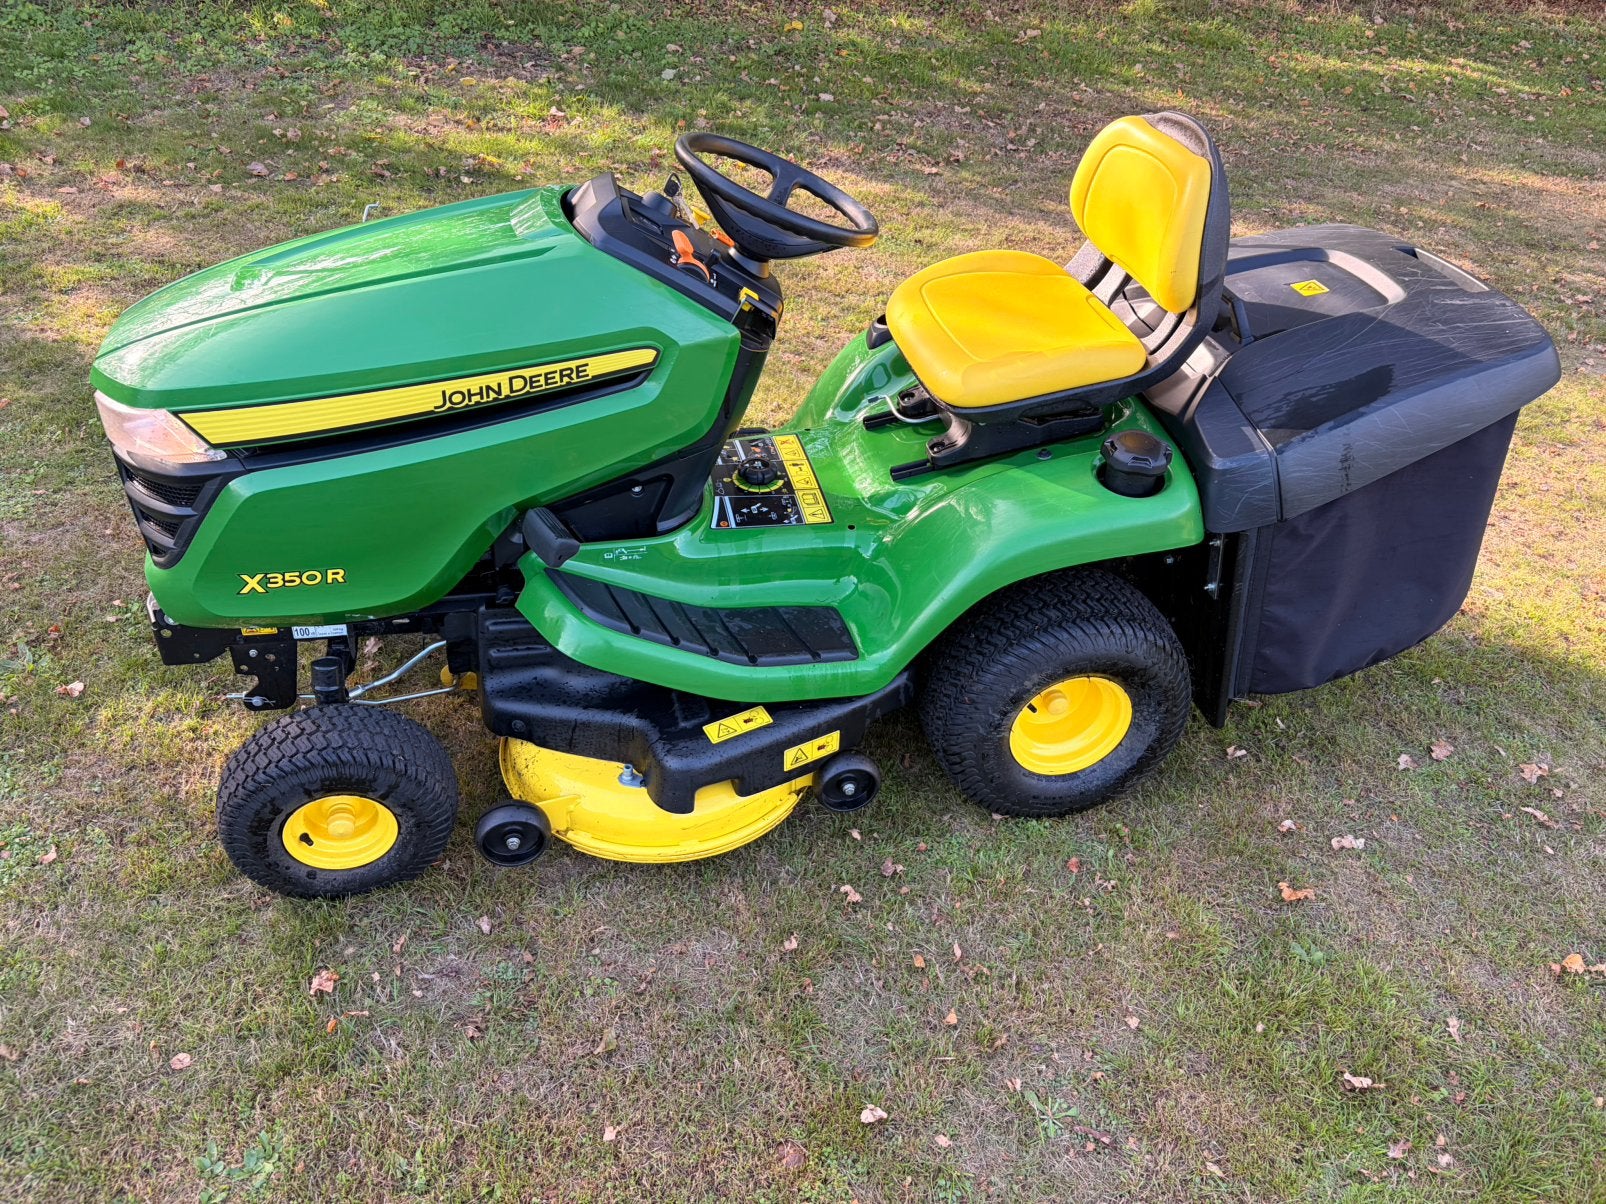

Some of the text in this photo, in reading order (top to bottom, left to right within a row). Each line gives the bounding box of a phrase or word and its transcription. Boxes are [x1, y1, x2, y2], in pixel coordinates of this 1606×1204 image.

[433, 362, 590, 410] JOHN DEERE
[294, 627, 310, 637] 100
